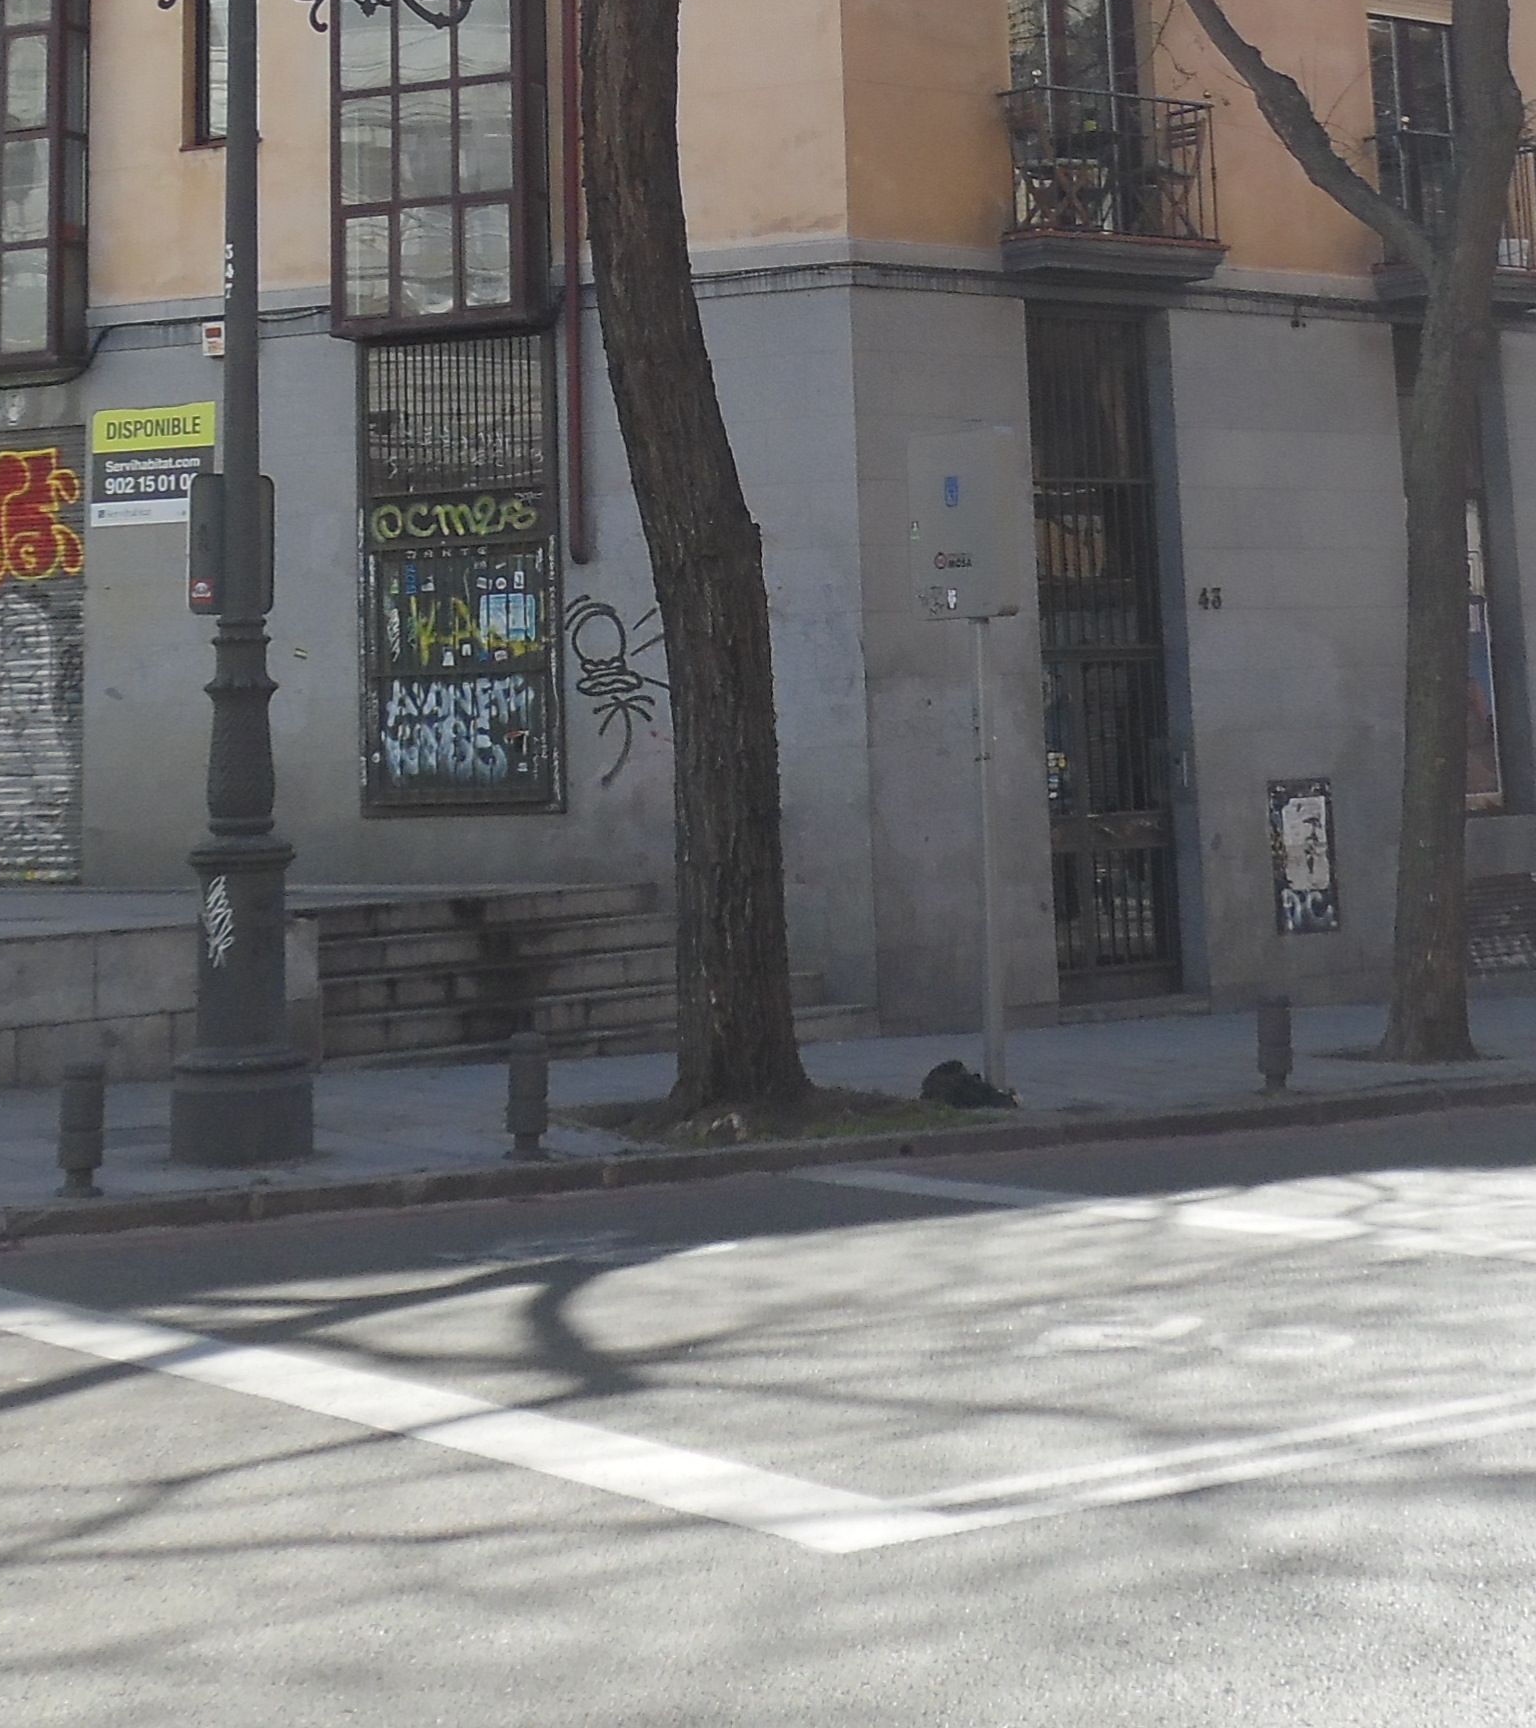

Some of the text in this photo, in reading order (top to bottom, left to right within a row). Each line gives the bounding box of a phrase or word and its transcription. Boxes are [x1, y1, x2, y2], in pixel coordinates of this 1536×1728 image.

[106, 416, 201, 441] DISPONIBLE
[105, 458, 200, 473] Servihabitat.com
[105, 476, 135, 495] 902
[136, 475, 155, 493] 15
[157, 474, 176, 492] 01
